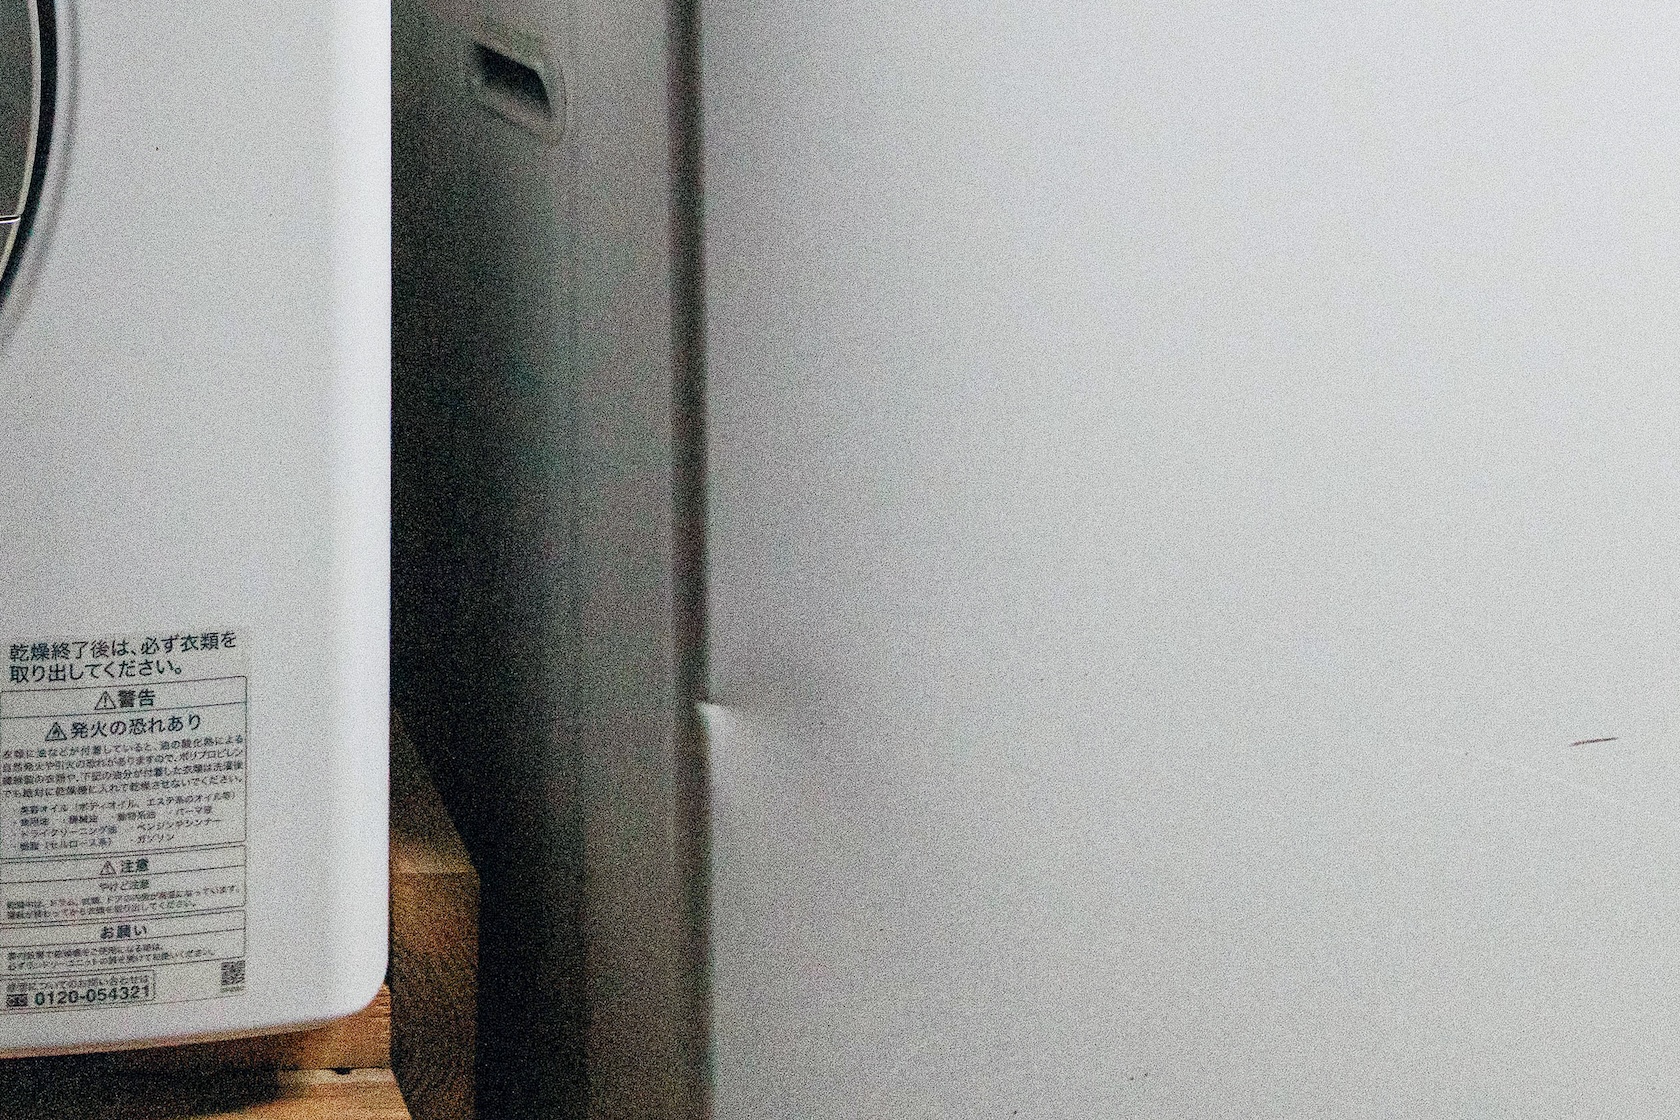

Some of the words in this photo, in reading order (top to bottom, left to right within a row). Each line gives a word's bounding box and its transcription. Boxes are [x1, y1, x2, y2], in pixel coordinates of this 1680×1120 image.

[9, 631, 237, 663] 乾燥終了後は、必ず衣類を
[10, 658, 182, 684] 取り出してください。
[118, 688, 156, 709] 警告
[70, 714, 202, 740] 発火の恐れあり
[120, 858, 149, 873] 注意
[100, 924, 148, 940] お願い
[34, 984, 151, 1006] 0120-054321
